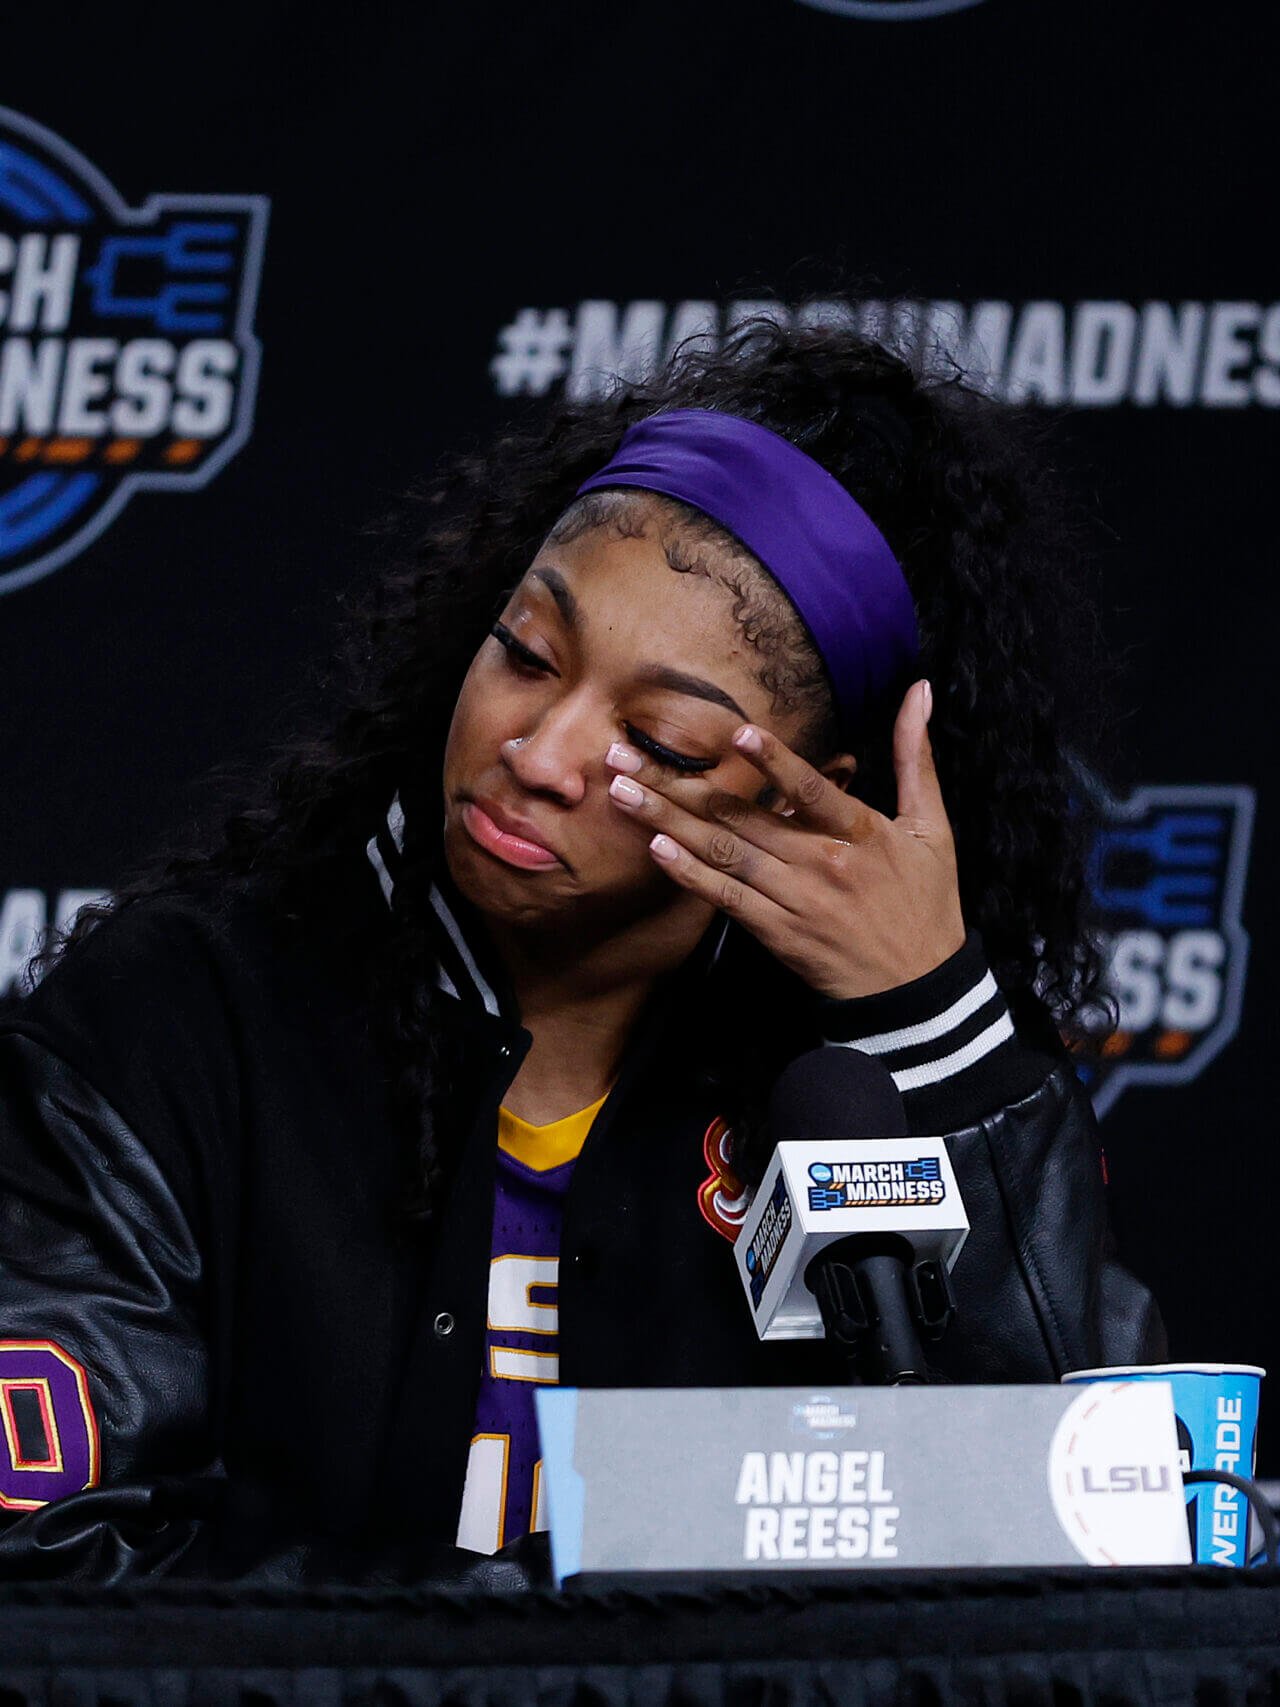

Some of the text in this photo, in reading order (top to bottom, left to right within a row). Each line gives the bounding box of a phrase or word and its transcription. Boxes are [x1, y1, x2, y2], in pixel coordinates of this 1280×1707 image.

[832, 1163, 905, 1183] MARCH
[847, 1179, 945, 1201] MADNESS
[753, 1200, 777, 1262] MARCH
[761, 1196, 791, 1276] MADNESS
[735, 1450, 894, 1505] ANGEL
[1081, 1464, 1171, 1494] LSU
[743, 1506, 900, 1561] REESE
